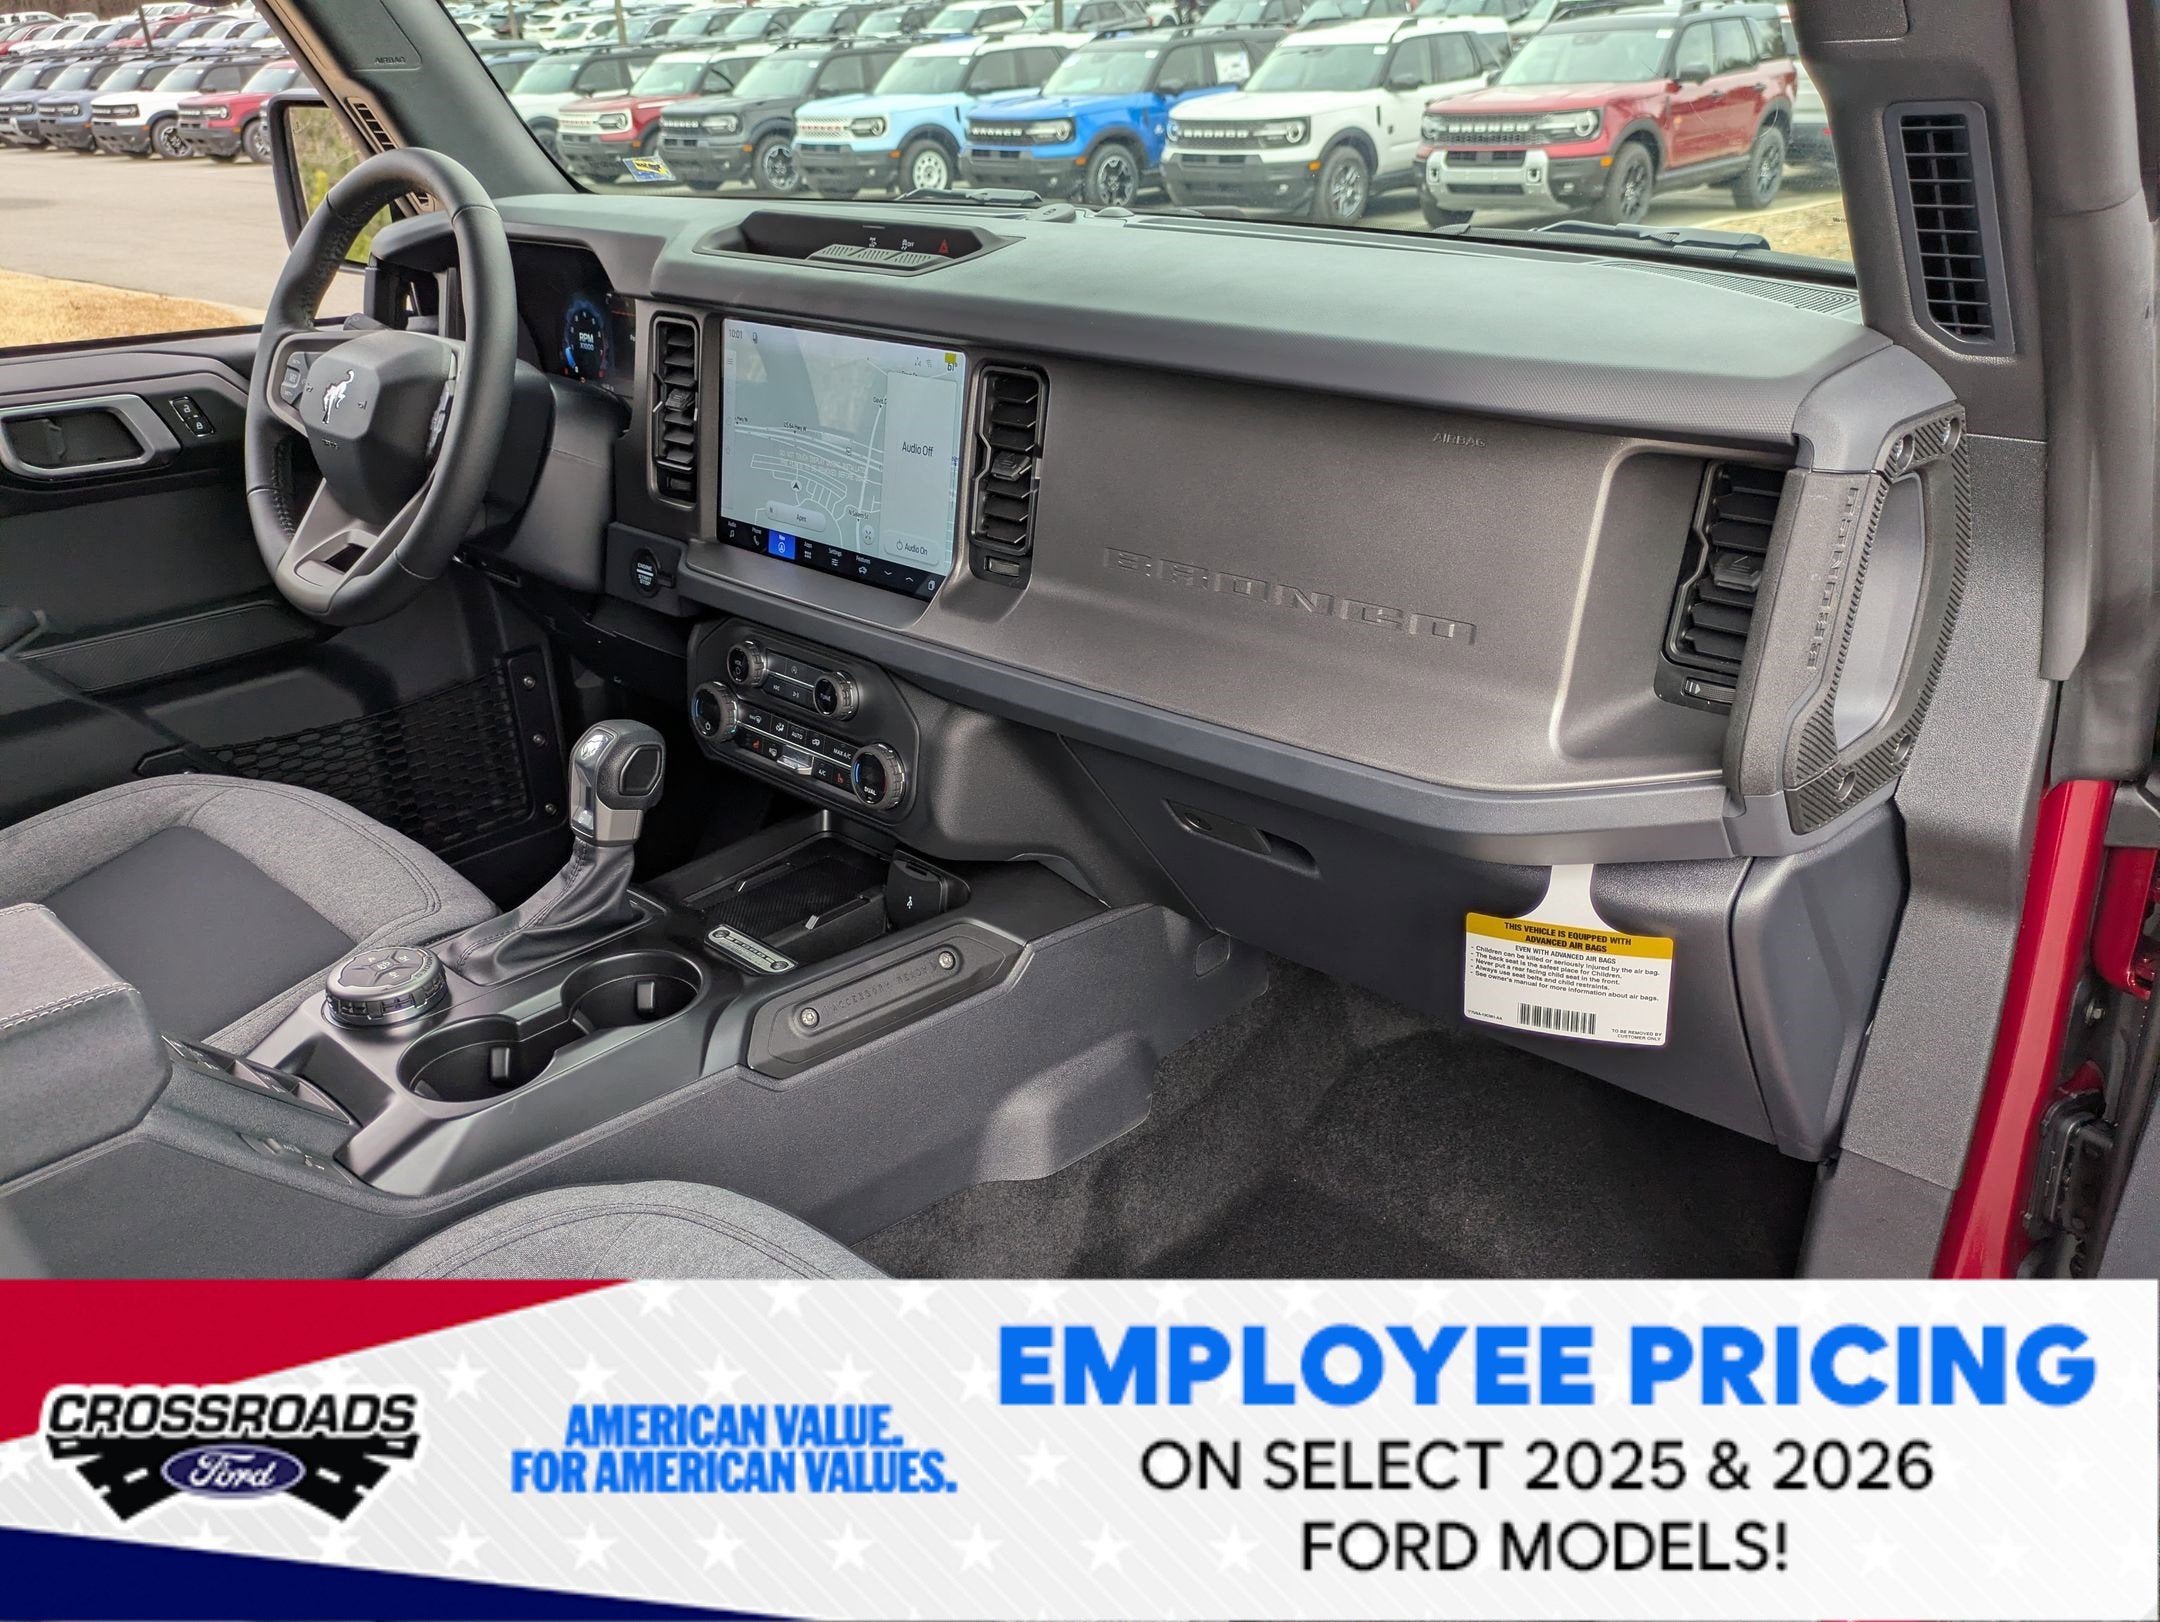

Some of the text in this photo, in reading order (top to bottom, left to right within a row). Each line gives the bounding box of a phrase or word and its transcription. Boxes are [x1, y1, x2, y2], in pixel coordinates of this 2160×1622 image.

[1183, 128, 1249, 138] BRONCO
[1448, 122, 1530, 133] BRONCO
[579, 332, 594, 343] RPM
[902, 441, 934, 457] Audio Off
[1433, 432, 1488, 448] AIRBAG
[905, 543, 928, 556] Audio On
[1104, 546, 1477, 645] BRONCO
[1504, 922, 1522, 931] THIS
[1524, 925, 1556, 936] VEHICLE
[1568, 931, 1607, 943] EQUIPPED
[1609, 937, 1632, 945] WITH
[1525, 935, 1607, 952] ADVANCED AIR BAGS
[1476, 945, 1502, 955] Children
[1526, 954, 1544, 962] killed
[1553, 959, 1585, 969] seriously
[1586, 962, 1610, 972] injured
[1644, 969, 1660, 977] bag.
[1515, 945, 1531, 953] EVEN
[1533, 947, 1549, 956] WITH
[1551, 950, 1584, 961] ADVANCED
[1598, 957, 1616, 965] BAGS
[1475, 958, 1494, 966] Never
[1494, 961, 1505, 969] put
[1526, 967, 1546, 976] facing
[1547, 970, 1564, 979] child
[1488, 954, 1504, 962] back
[1539, 962, 1559, 971] safest
[1560, 966, 1579, 974] place
[1591, 970, 1622, 979] Children.
[1475, 964, 1498, 974] Always
[1527, 973, 1543, 981] belts
[1558, 979, 1575, 987] child
[1576, 981, 1610, 991] restraints.
[1488, 974, 1512, 983] owner's
[1514, 977, 1538, 987] manual
[1567, 986, 1607, 997] information
[1640, 994, 1659, 1002] bags.
